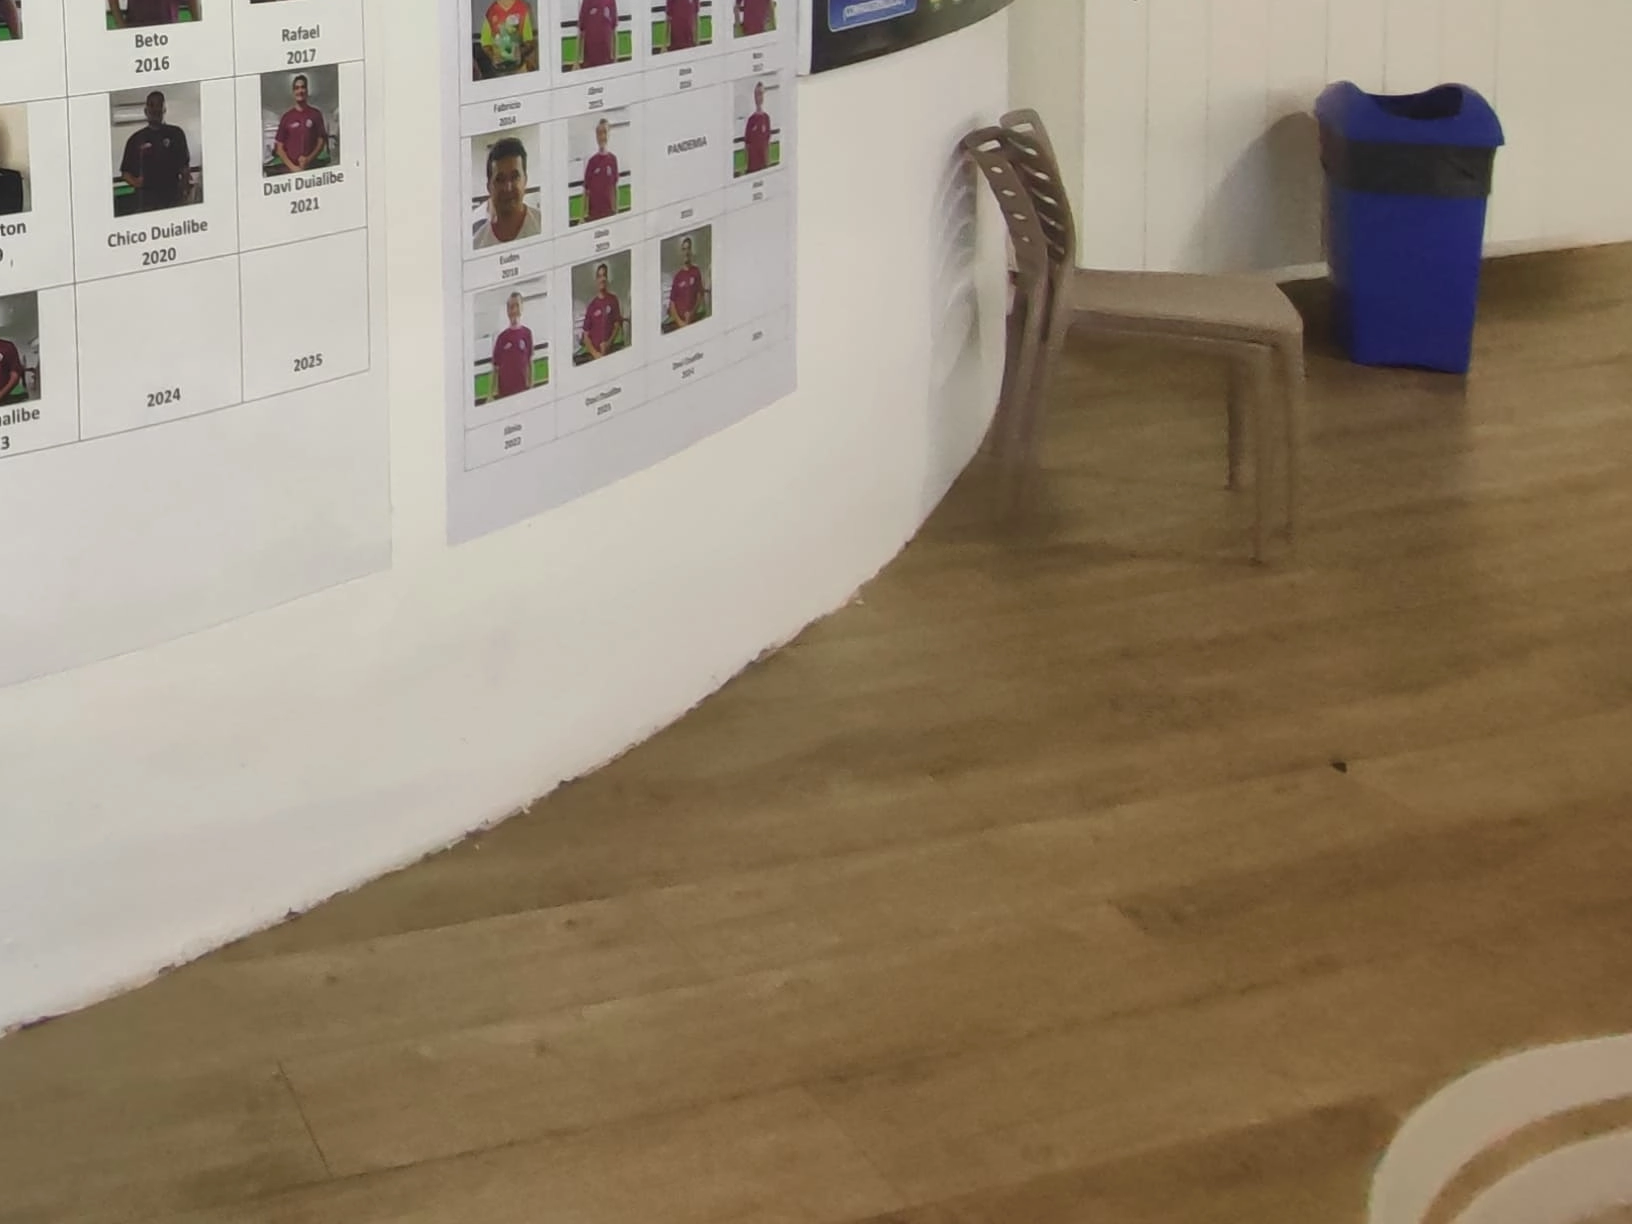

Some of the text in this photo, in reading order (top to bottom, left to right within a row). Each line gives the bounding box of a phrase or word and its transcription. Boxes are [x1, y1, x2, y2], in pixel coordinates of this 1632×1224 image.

[134, 32, 168, 49] Beto
[281, 25, 320, 43] Rafael
[134, 56, 170, 74] 2016
[286, 49, 316, 65] 2017
[263, 170, 345, 196] Davi Duialibe
[290, 197, 320, 215] 2021
[107, 219, 209, 248] Chico Duialibe
[141, 247, 177, 266] 2020
[293, 353, 324, 373] 2025
[146, 388, 181, 408] 2024
